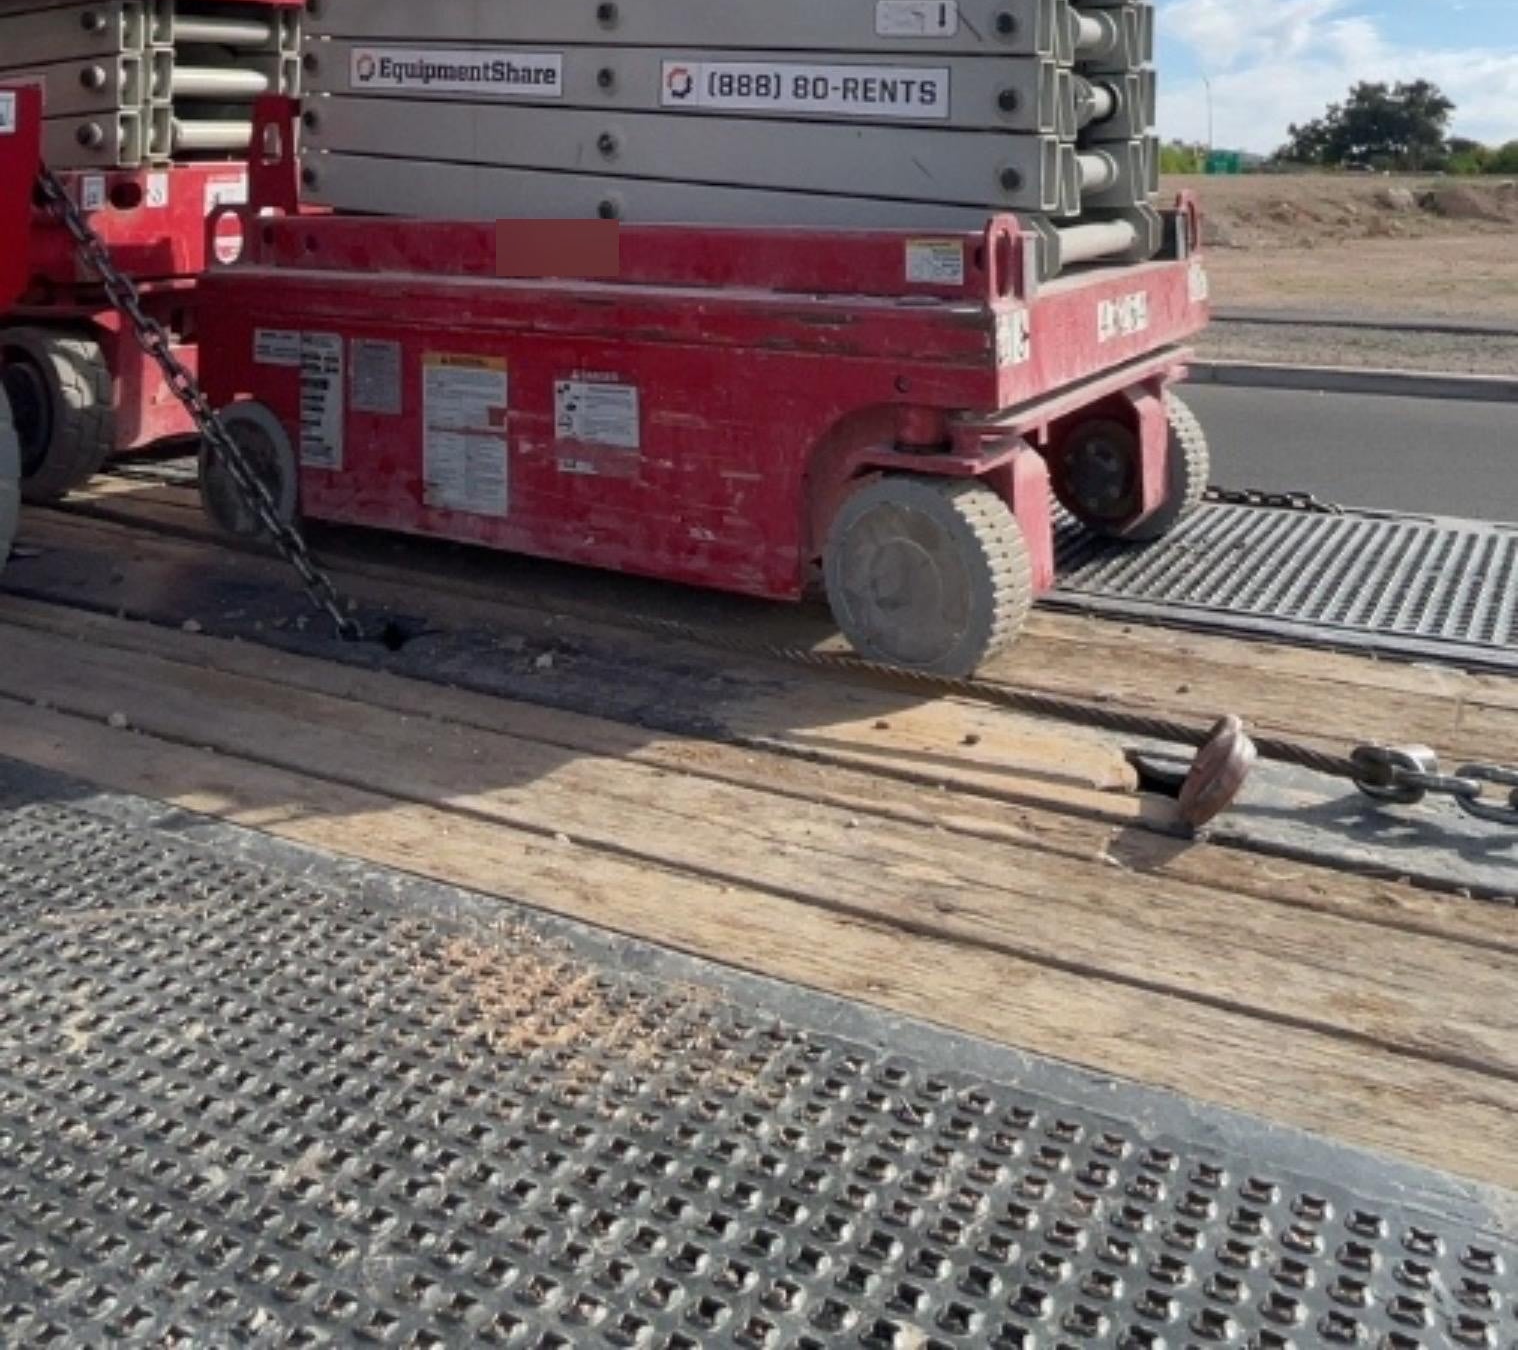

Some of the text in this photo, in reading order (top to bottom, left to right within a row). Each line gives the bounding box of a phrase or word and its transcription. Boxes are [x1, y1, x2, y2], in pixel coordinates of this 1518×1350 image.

[378, 56, 557, 85] EquipmentShare
[707, 71, 938, 106] (888) 80-RENTS
